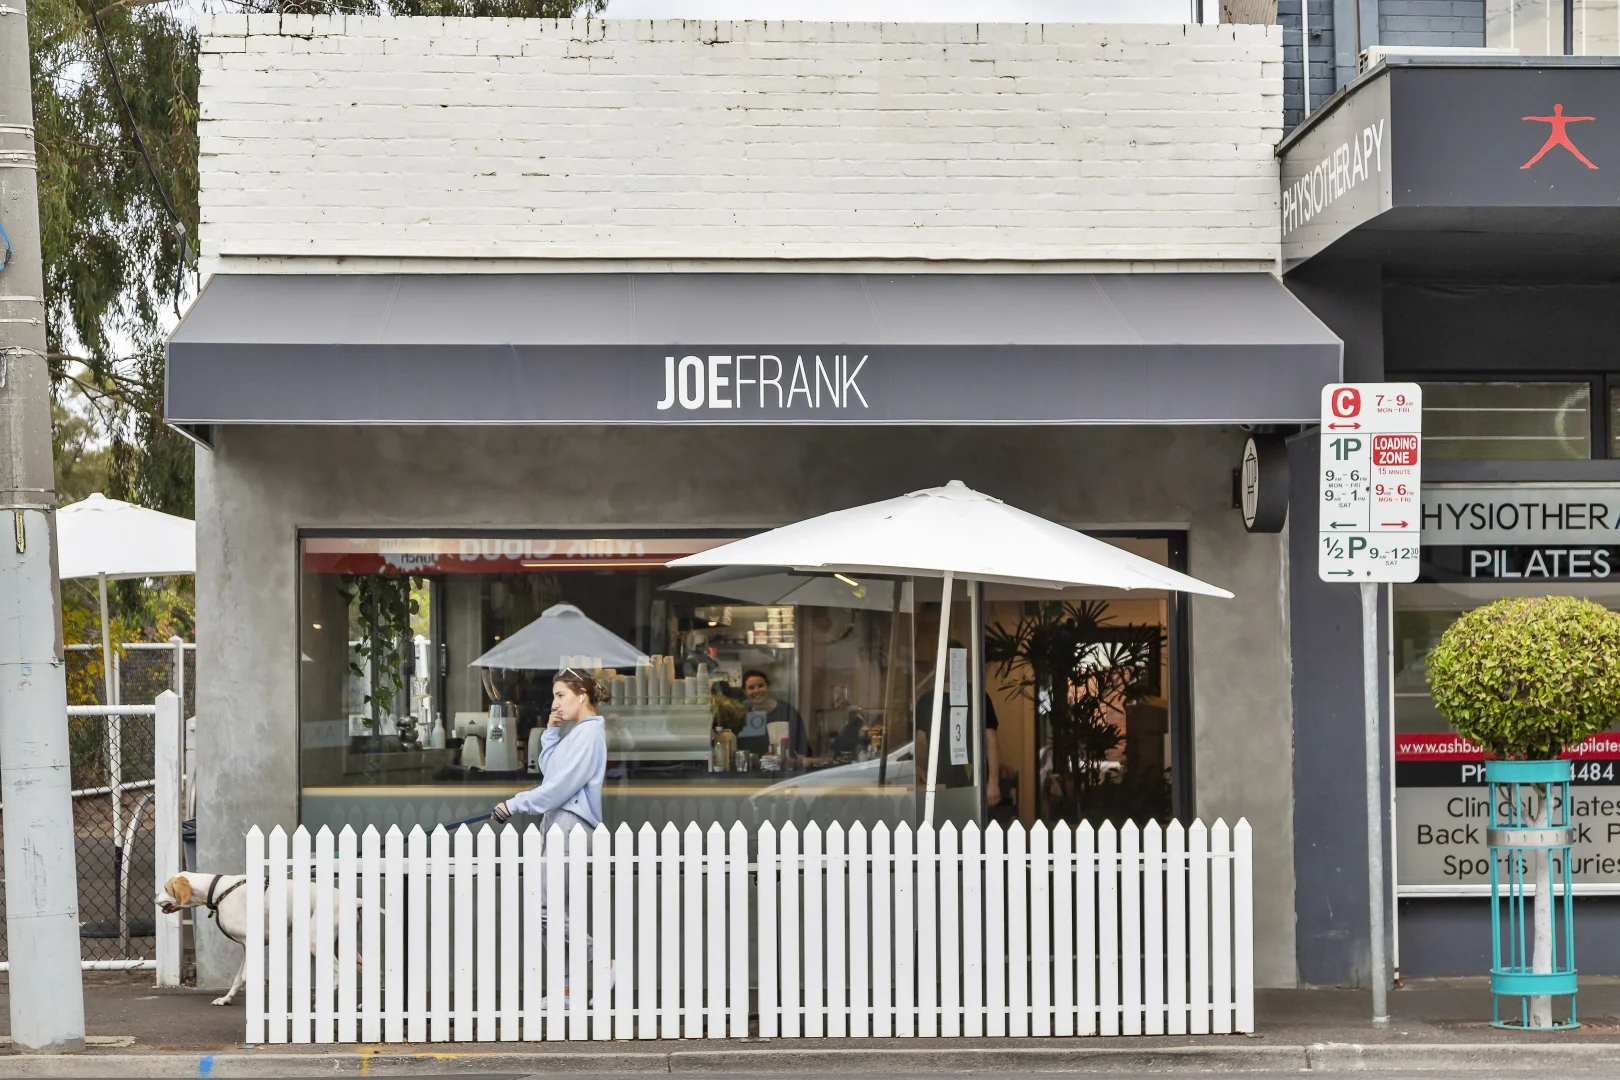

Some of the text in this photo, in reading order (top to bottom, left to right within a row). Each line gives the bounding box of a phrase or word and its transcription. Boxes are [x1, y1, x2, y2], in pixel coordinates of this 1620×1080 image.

[1283, 119, 1384, 236] PHYSIOTHERAPY
[1330, 438, 1362, 460] 1P
[1375, 438, 1417, 450] LOADING
[1379, 451, 1410, 464] ZONE
[1421, 503, 1620, 530] HYSIOTHER
[1470, 550, 1611, 578] PILATES
[955, 724, 962, 742] 3
[1418, 824, 1480, 845] Back
[1443, 854, 1528, 880] Spots
